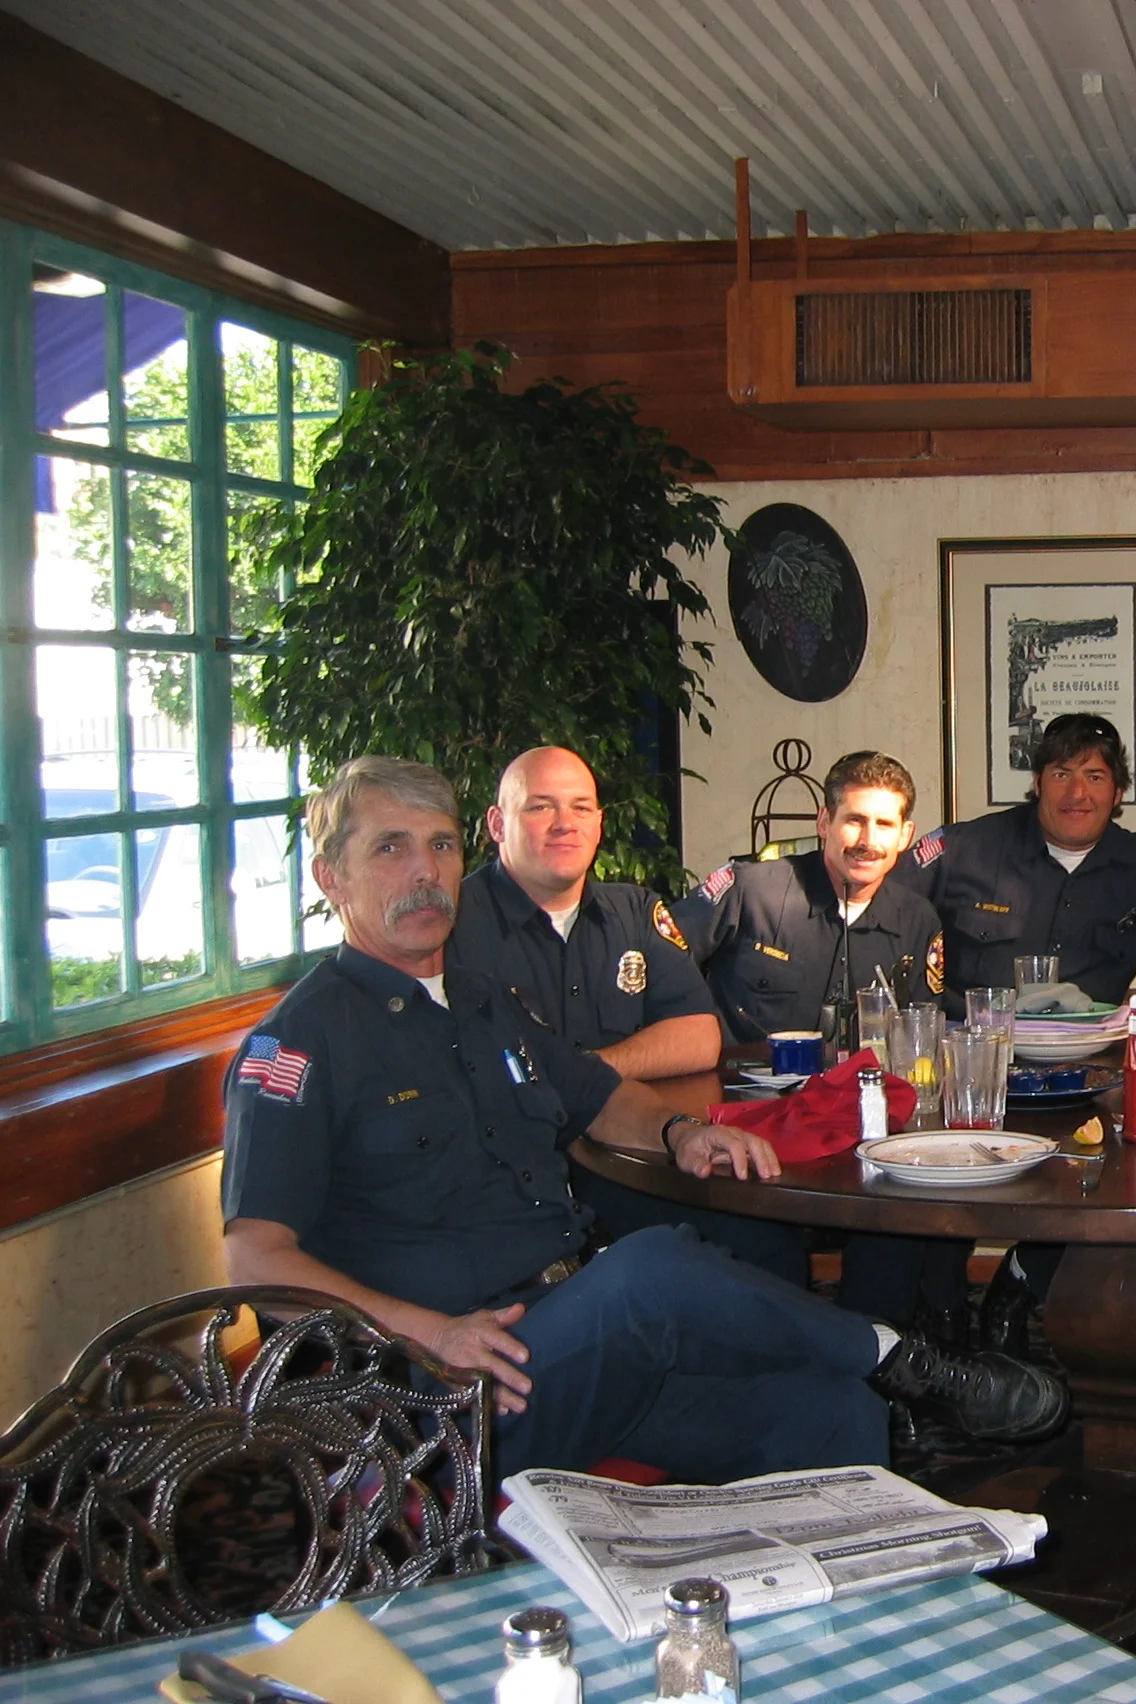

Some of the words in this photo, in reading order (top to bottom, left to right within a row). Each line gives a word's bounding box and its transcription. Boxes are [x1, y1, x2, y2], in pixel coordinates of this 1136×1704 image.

[1034, 682, 1047, 692] LA
[1052, 680, 1120, 692] BEAUJOLAISE
[819, 1542, 880, 1559] Christmas
[881, 1533, 932, 1550] Morning
[708, 1560, 797, 1584] Championship
